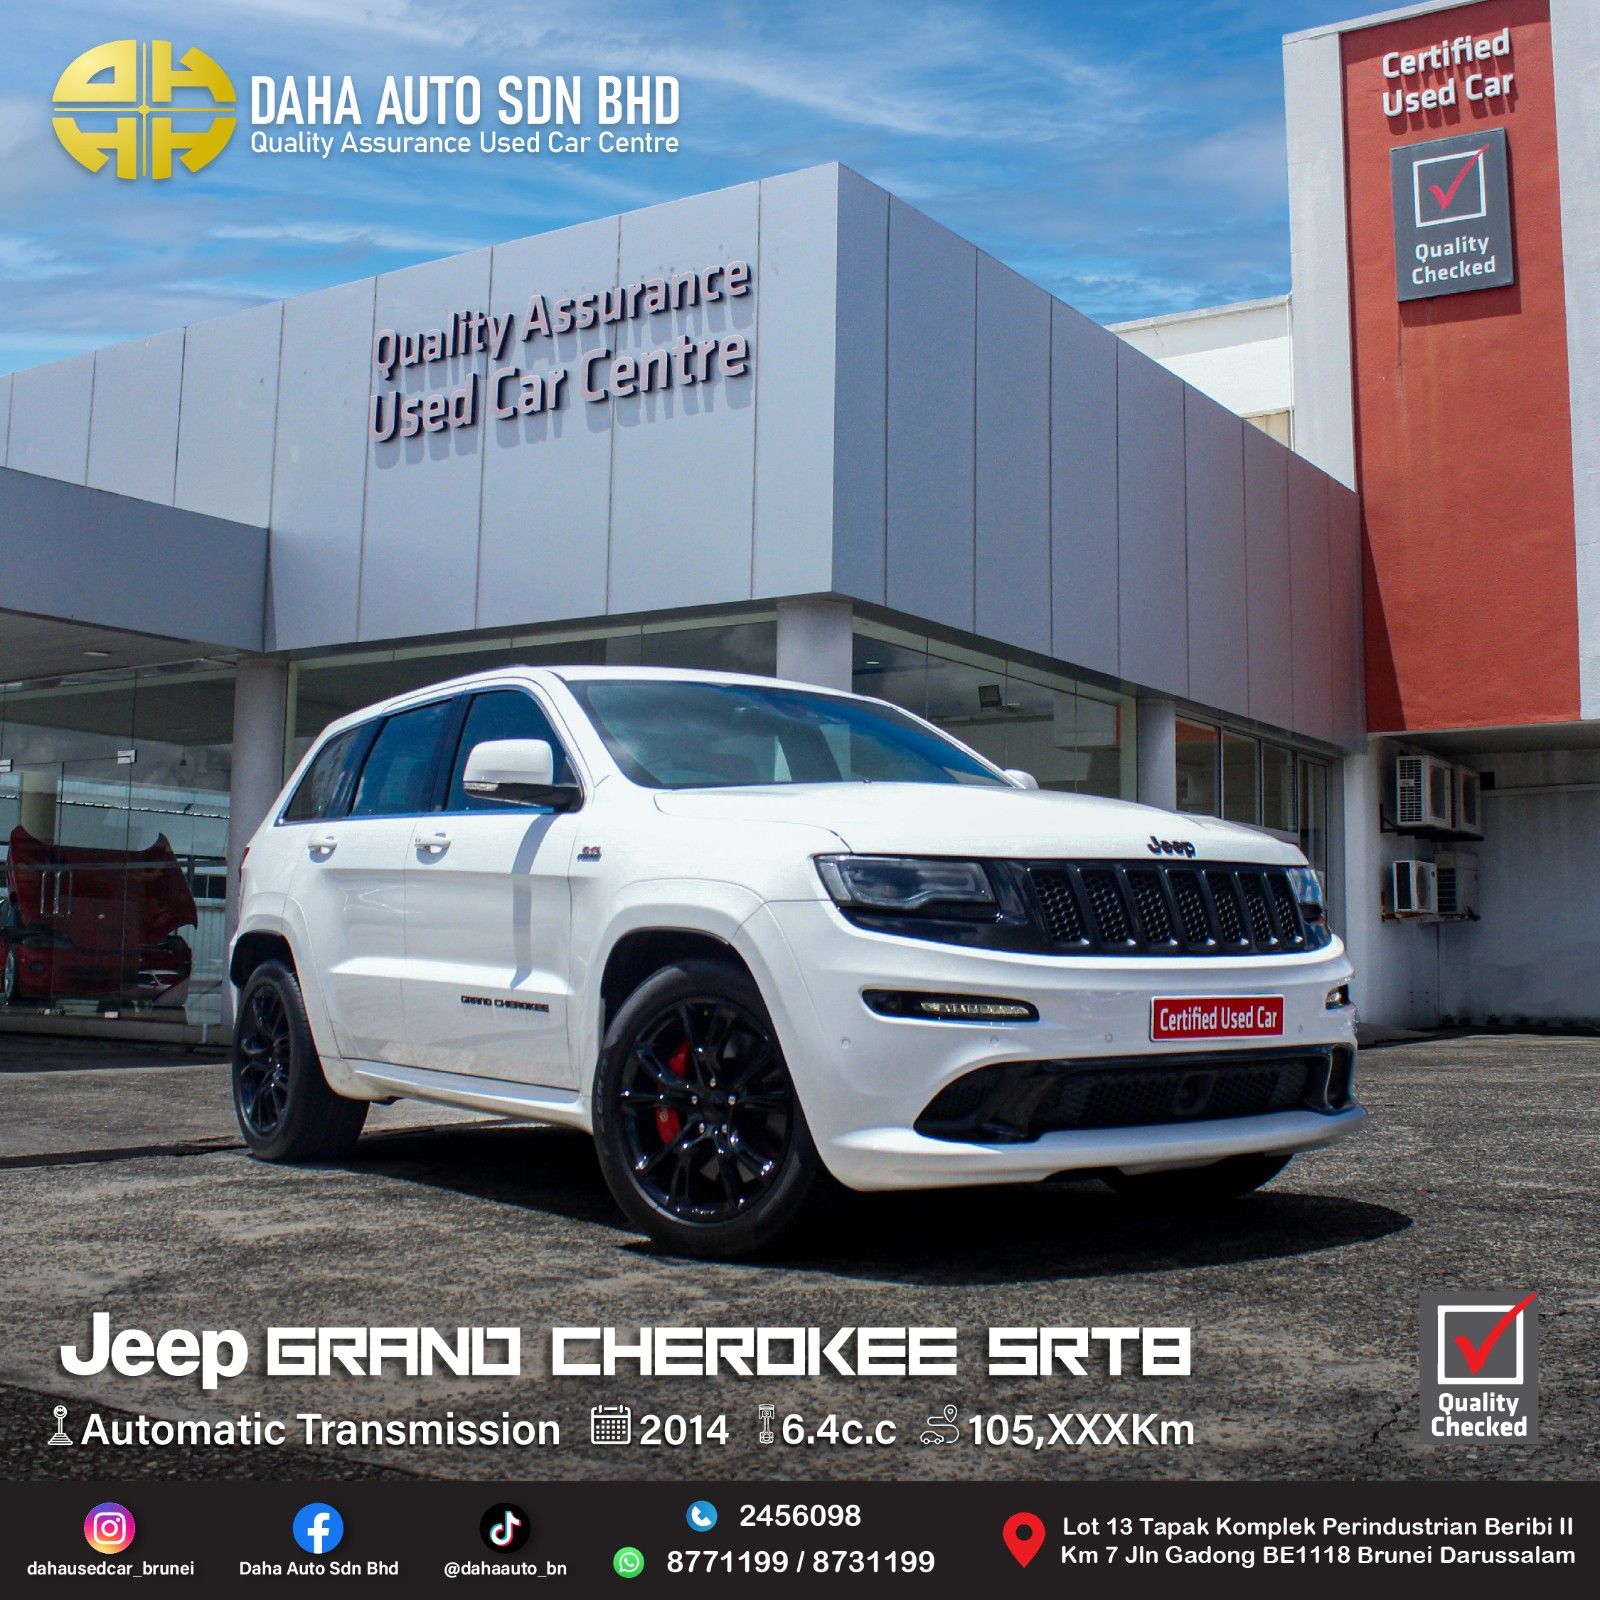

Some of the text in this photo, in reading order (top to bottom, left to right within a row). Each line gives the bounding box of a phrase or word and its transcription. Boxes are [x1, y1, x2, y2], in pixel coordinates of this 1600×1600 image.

[1382, 27, 1510, 79] Certified
[1382, 73, 1514, 117] Used Car
[1415, 235, 1490, 263] Quality
[1412, 256, 1496, 285] Checked
[372, 260, 752, 381] Quality Assurance
[370, 334, 751, 443] Used Car Centre
[1147, 835, 1197, 858] Jeep
[1159, 1005, 1278, 1032] Certified Used Car
